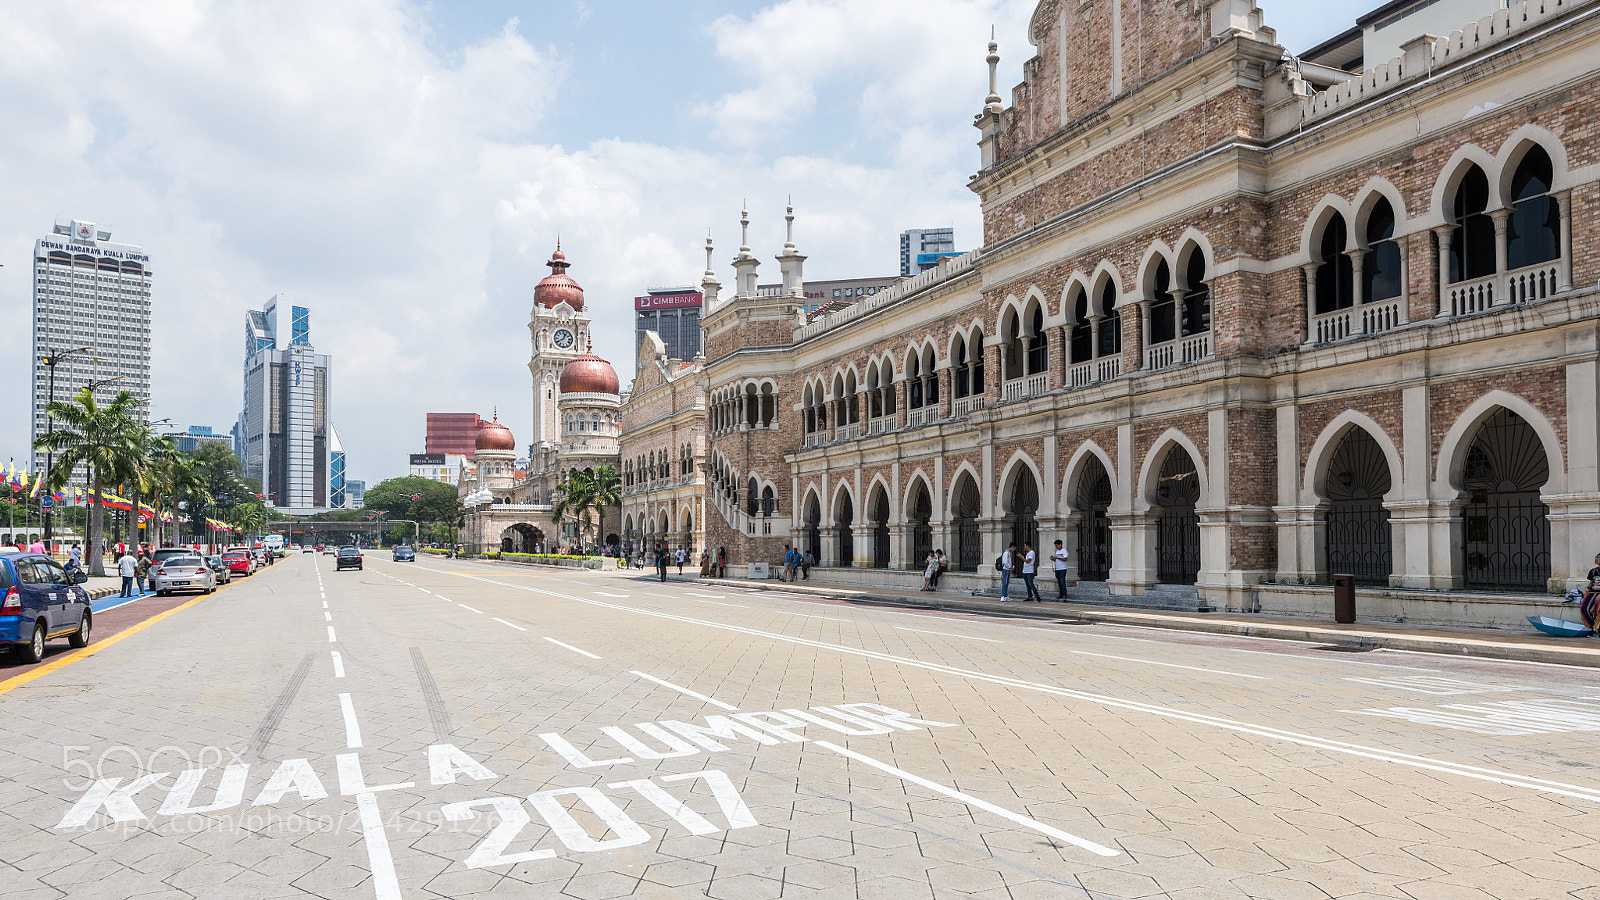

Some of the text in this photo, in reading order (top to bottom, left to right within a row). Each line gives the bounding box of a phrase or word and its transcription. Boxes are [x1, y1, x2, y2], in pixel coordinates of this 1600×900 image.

[41, 240, 149, 262] DEWAN BANDARAYA KUALA LUMPUR
[54, 703, 960, 829] KUALA LUMPUR
[441, 769, 760, 870] 2017
